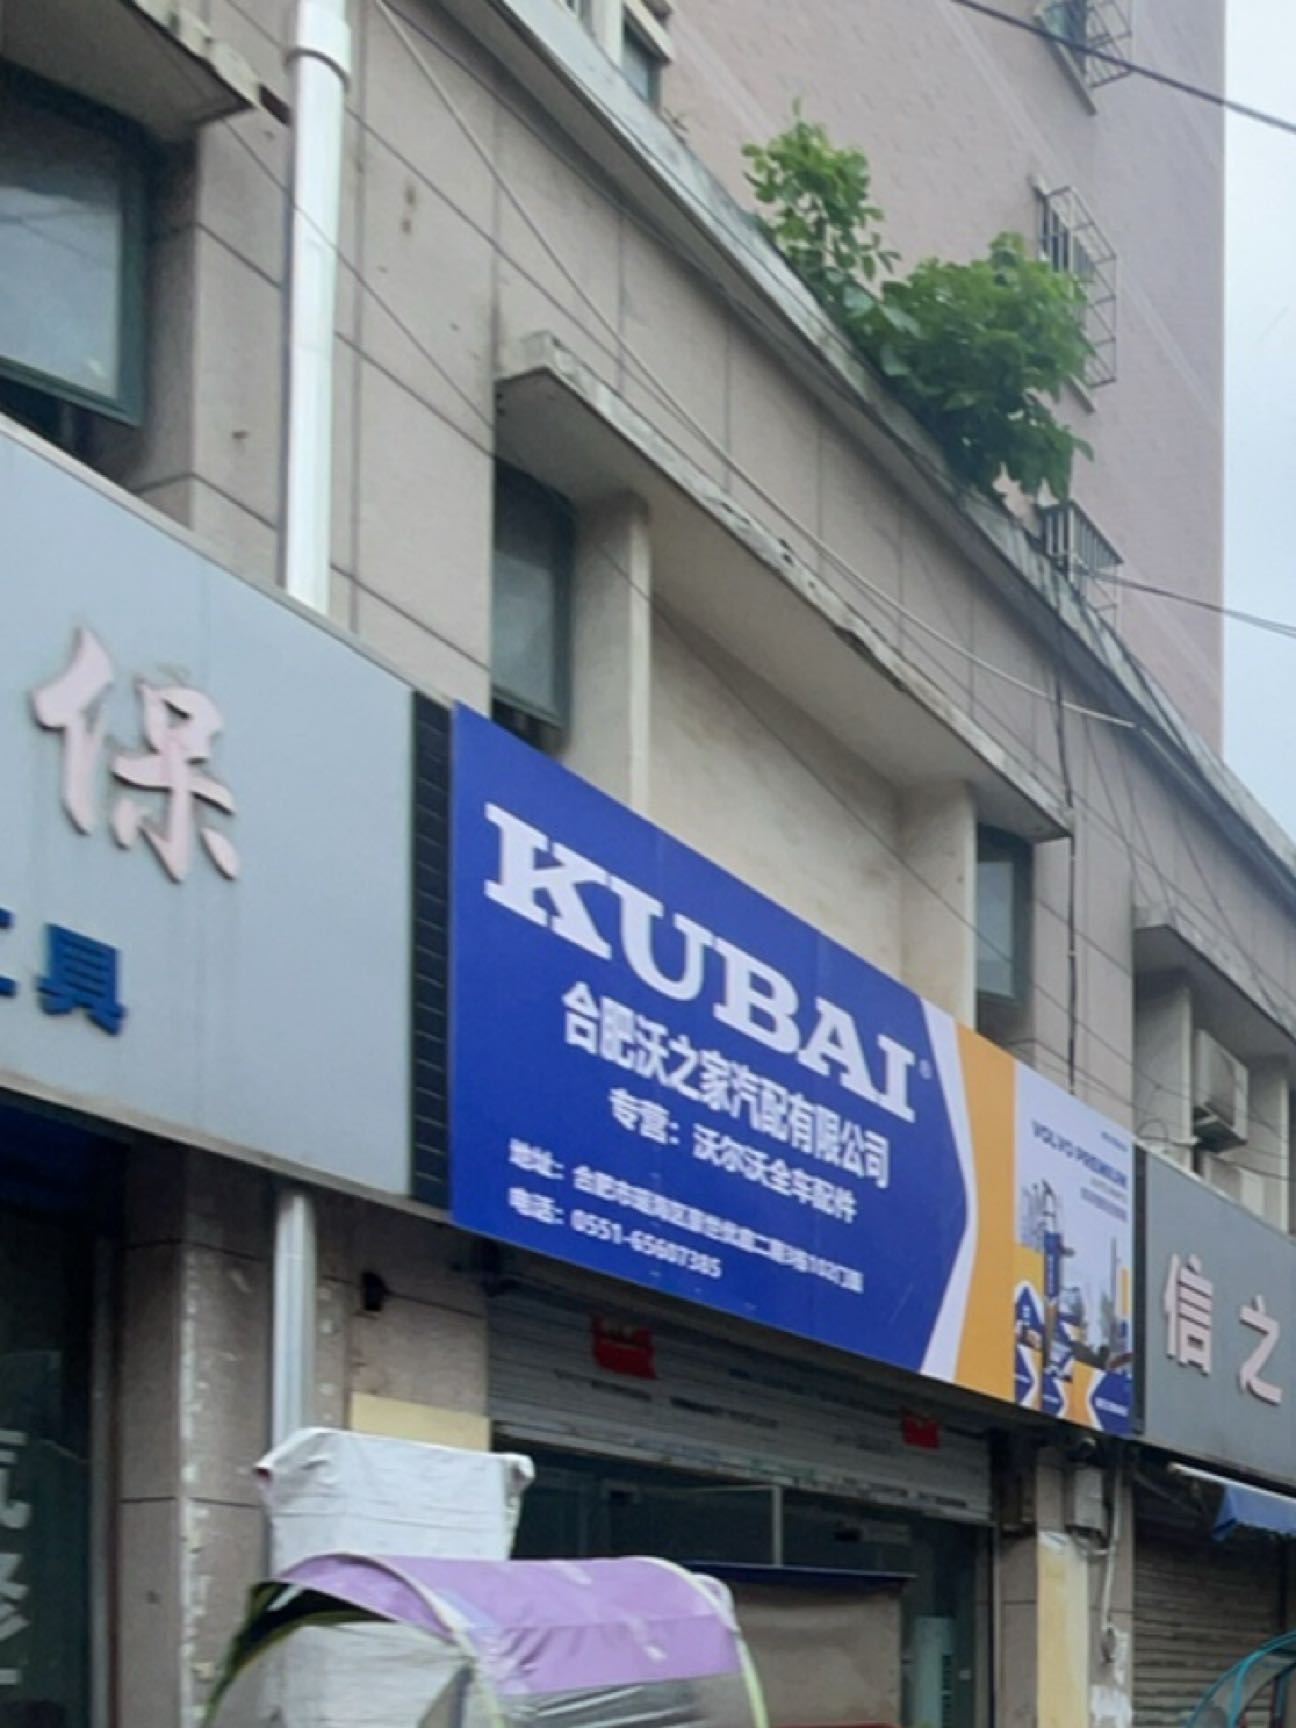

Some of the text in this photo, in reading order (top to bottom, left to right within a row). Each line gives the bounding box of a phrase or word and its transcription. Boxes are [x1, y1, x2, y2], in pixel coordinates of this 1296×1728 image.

[30, 624, 241, 884] 保
[0, 906, 127, 1037] 具
[484, 802, 917, 1124] KUBAI
[561, 981, 891, 1189] 合肥沃之家汽配有限公司
